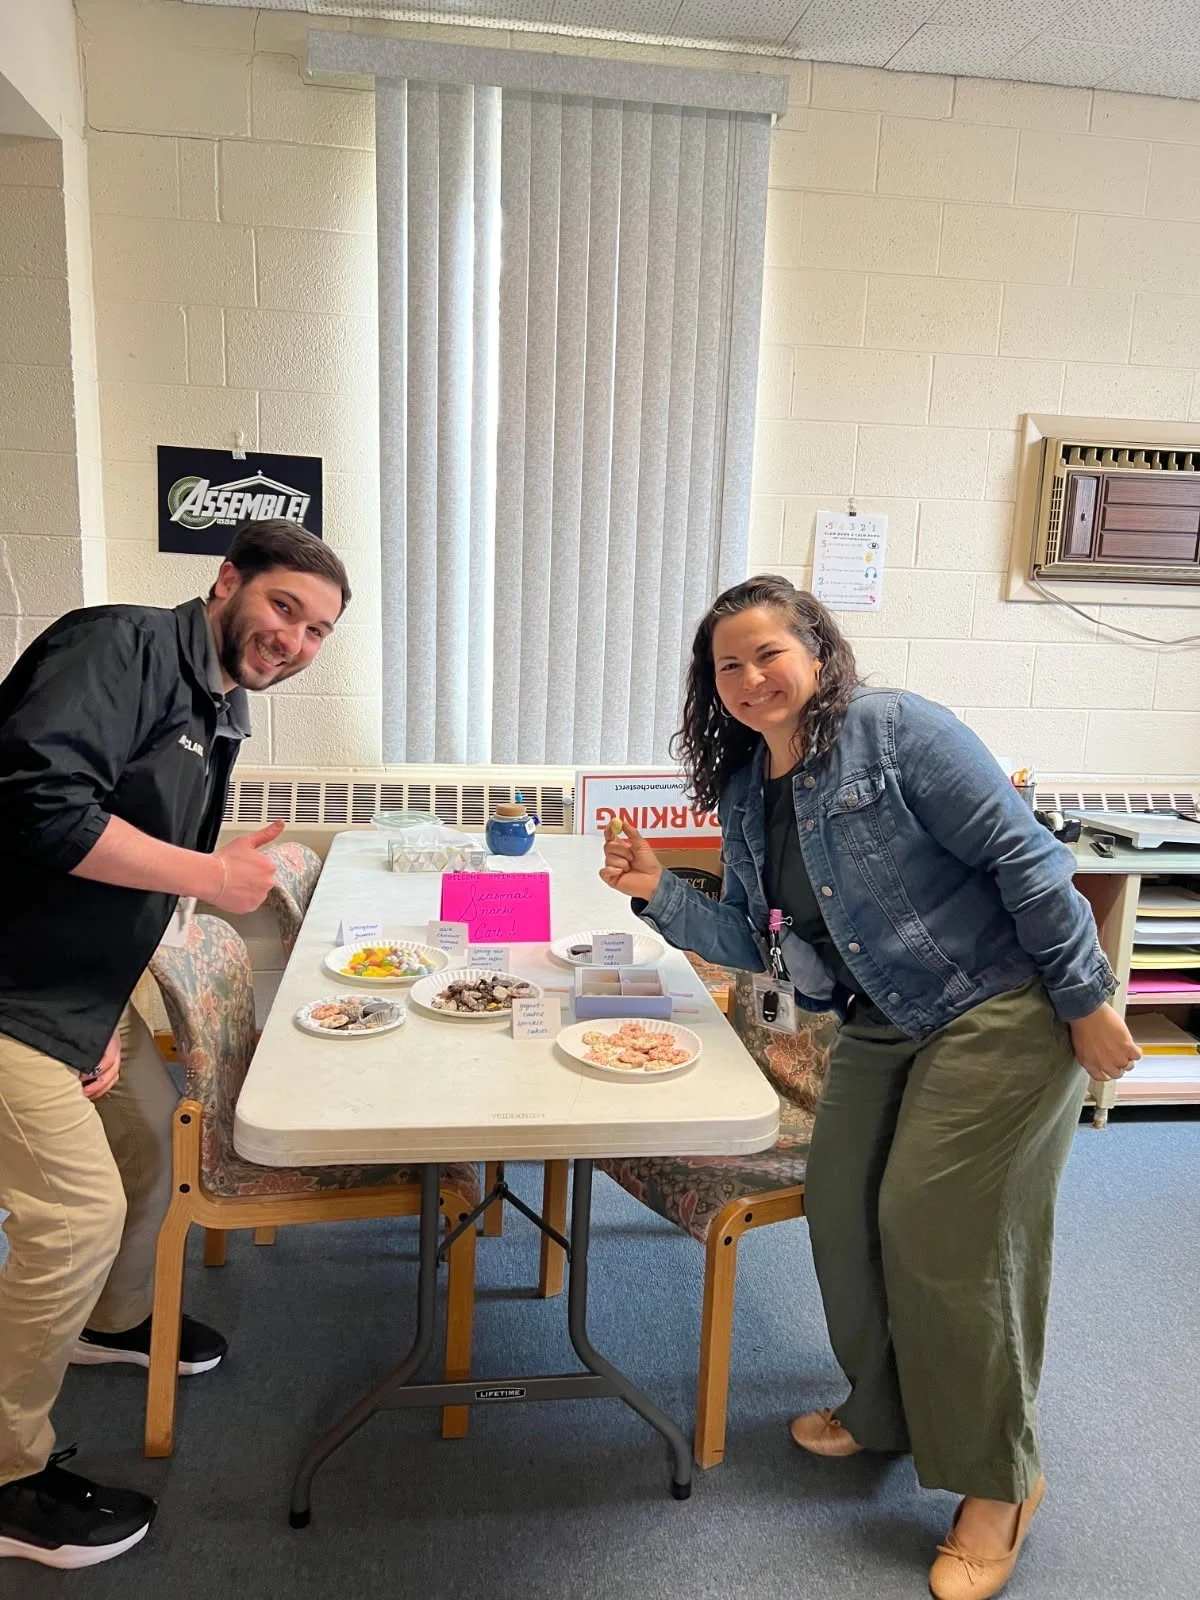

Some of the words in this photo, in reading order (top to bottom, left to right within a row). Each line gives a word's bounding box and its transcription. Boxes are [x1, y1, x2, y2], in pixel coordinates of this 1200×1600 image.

[169, 479, 311, 523] ASSEMBLE!
[860, 523, 866, 531] 2
[817, 577, 824, 586] 2
[480, 1390, 521, 1398] LIFETIME
